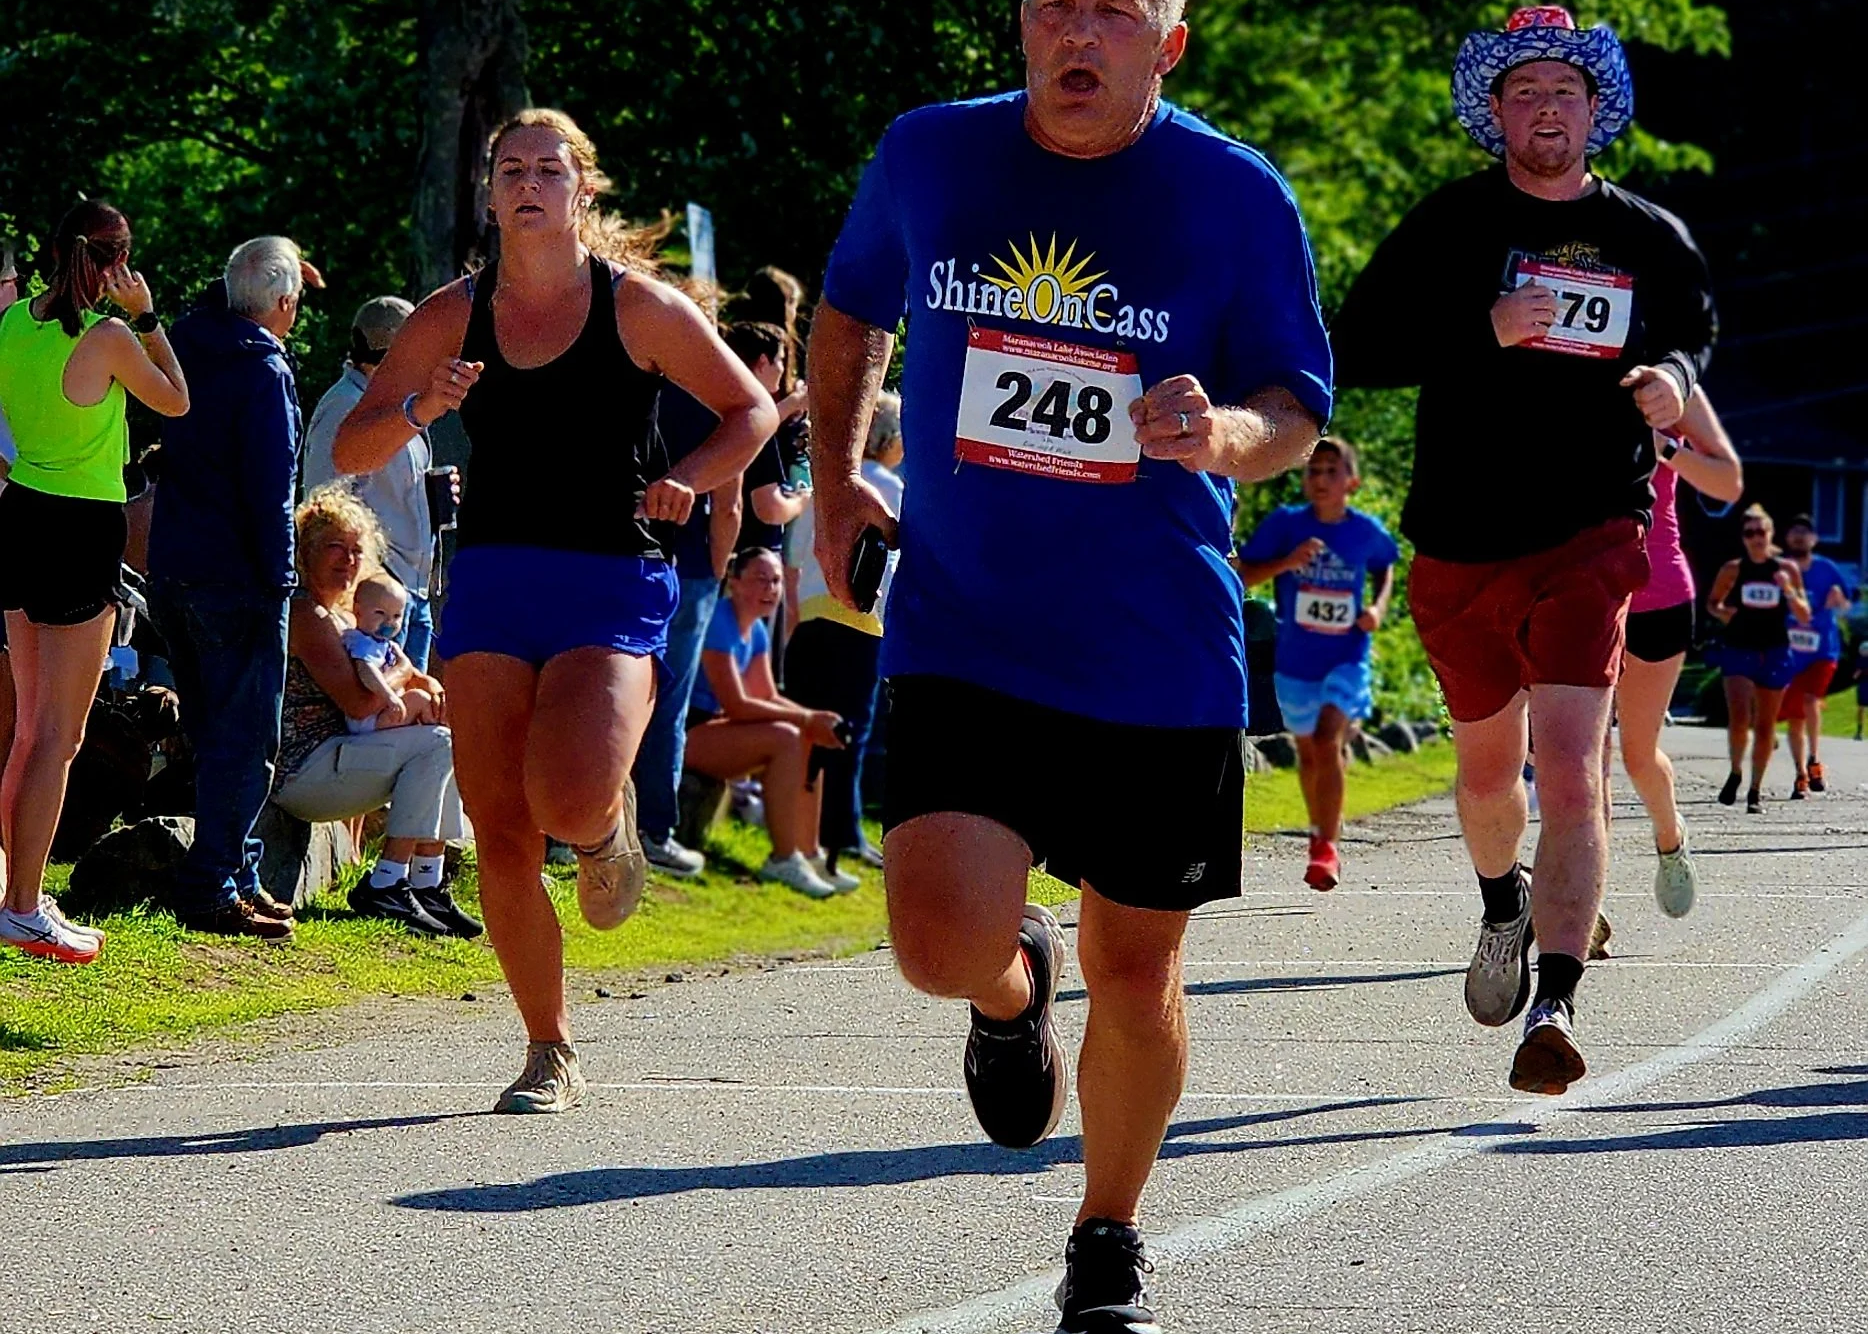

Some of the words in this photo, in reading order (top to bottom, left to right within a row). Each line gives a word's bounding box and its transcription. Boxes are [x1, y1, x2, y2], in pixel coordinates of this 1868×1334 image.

[926, 257, 1170, 343] ShineOnCass
[1552, 289, 1611, 333] 79
[1054, 343, 1073, 355] Lake
[1074, 348, 1118, 363] Association
[989, 371, 1113, 444] 248
[1008, 449, 1051, 464] Watershed
[1052, 456, 1083, 469] Friends
[1307, 600, 1348, 622] 432
